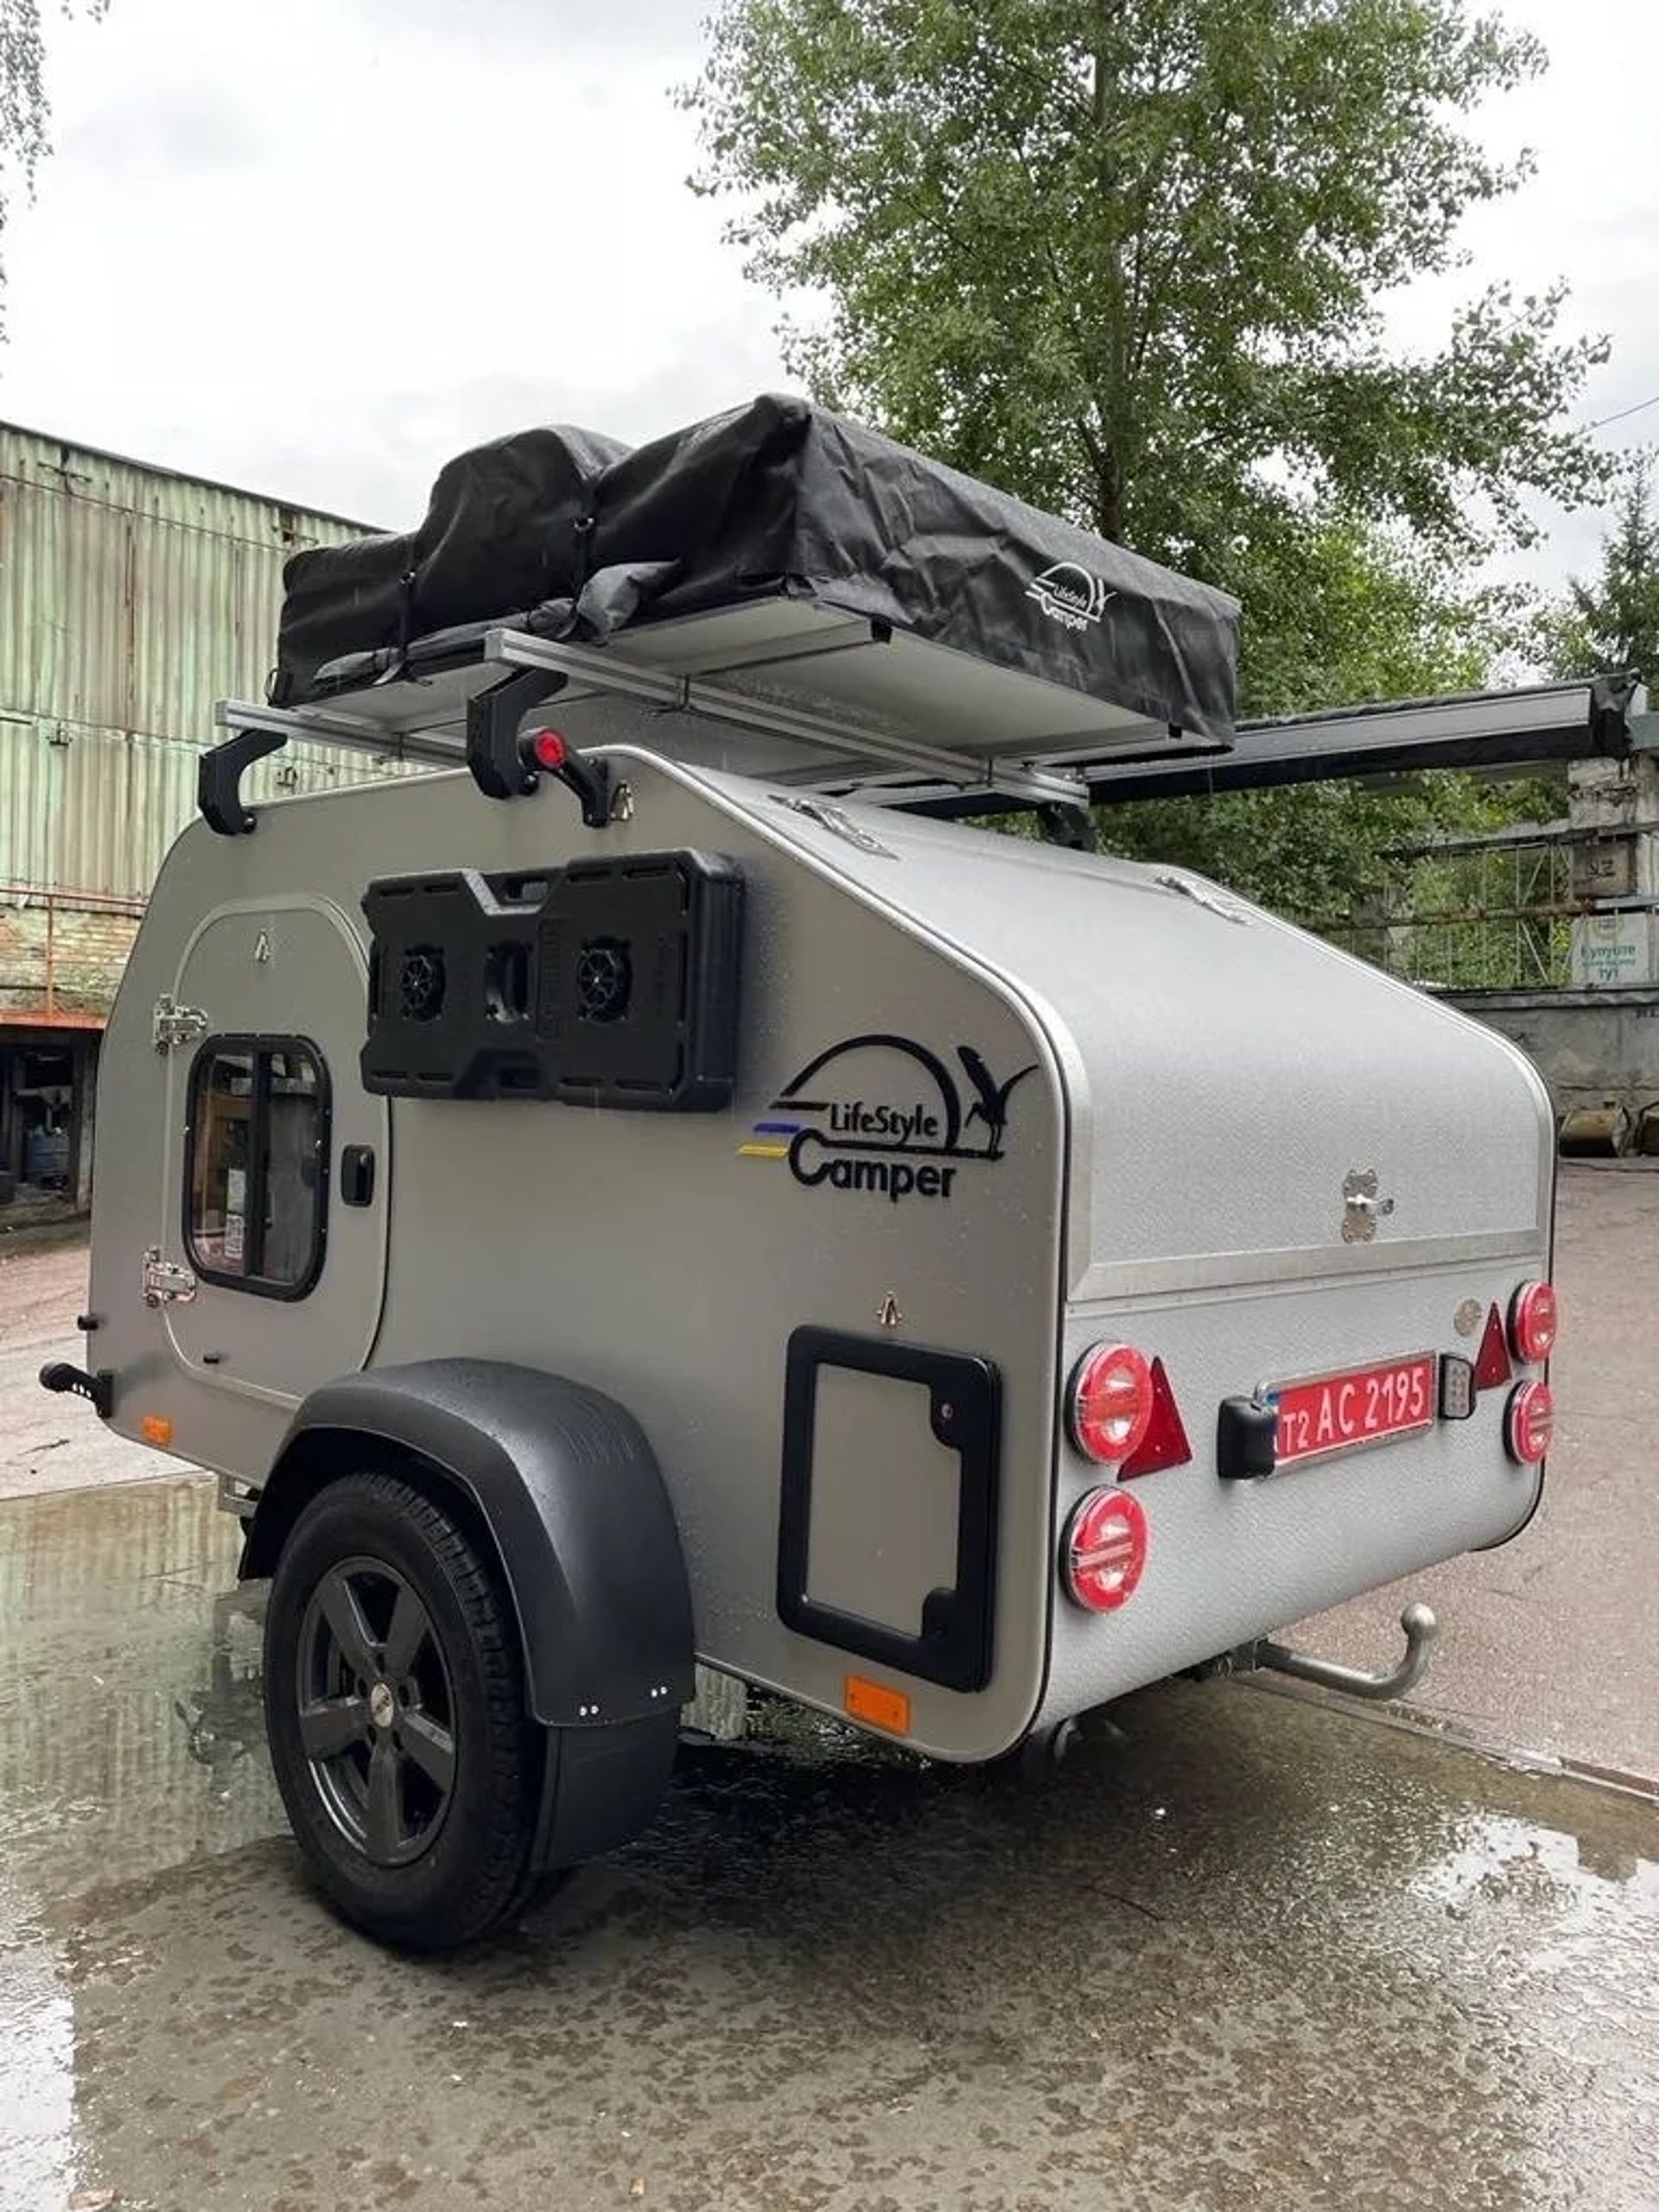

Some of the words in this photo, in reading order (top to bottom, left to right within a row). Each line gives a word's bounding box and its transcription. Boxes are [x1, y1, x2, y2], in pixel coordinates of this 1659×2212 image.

[830, 1102, 938, 1146] LifeStyle
[788, 1128, 957, 1203] Camper
[1316, 1382, 1356, 1442] AC
[1364, 1368, 1425, 1430] 2195
